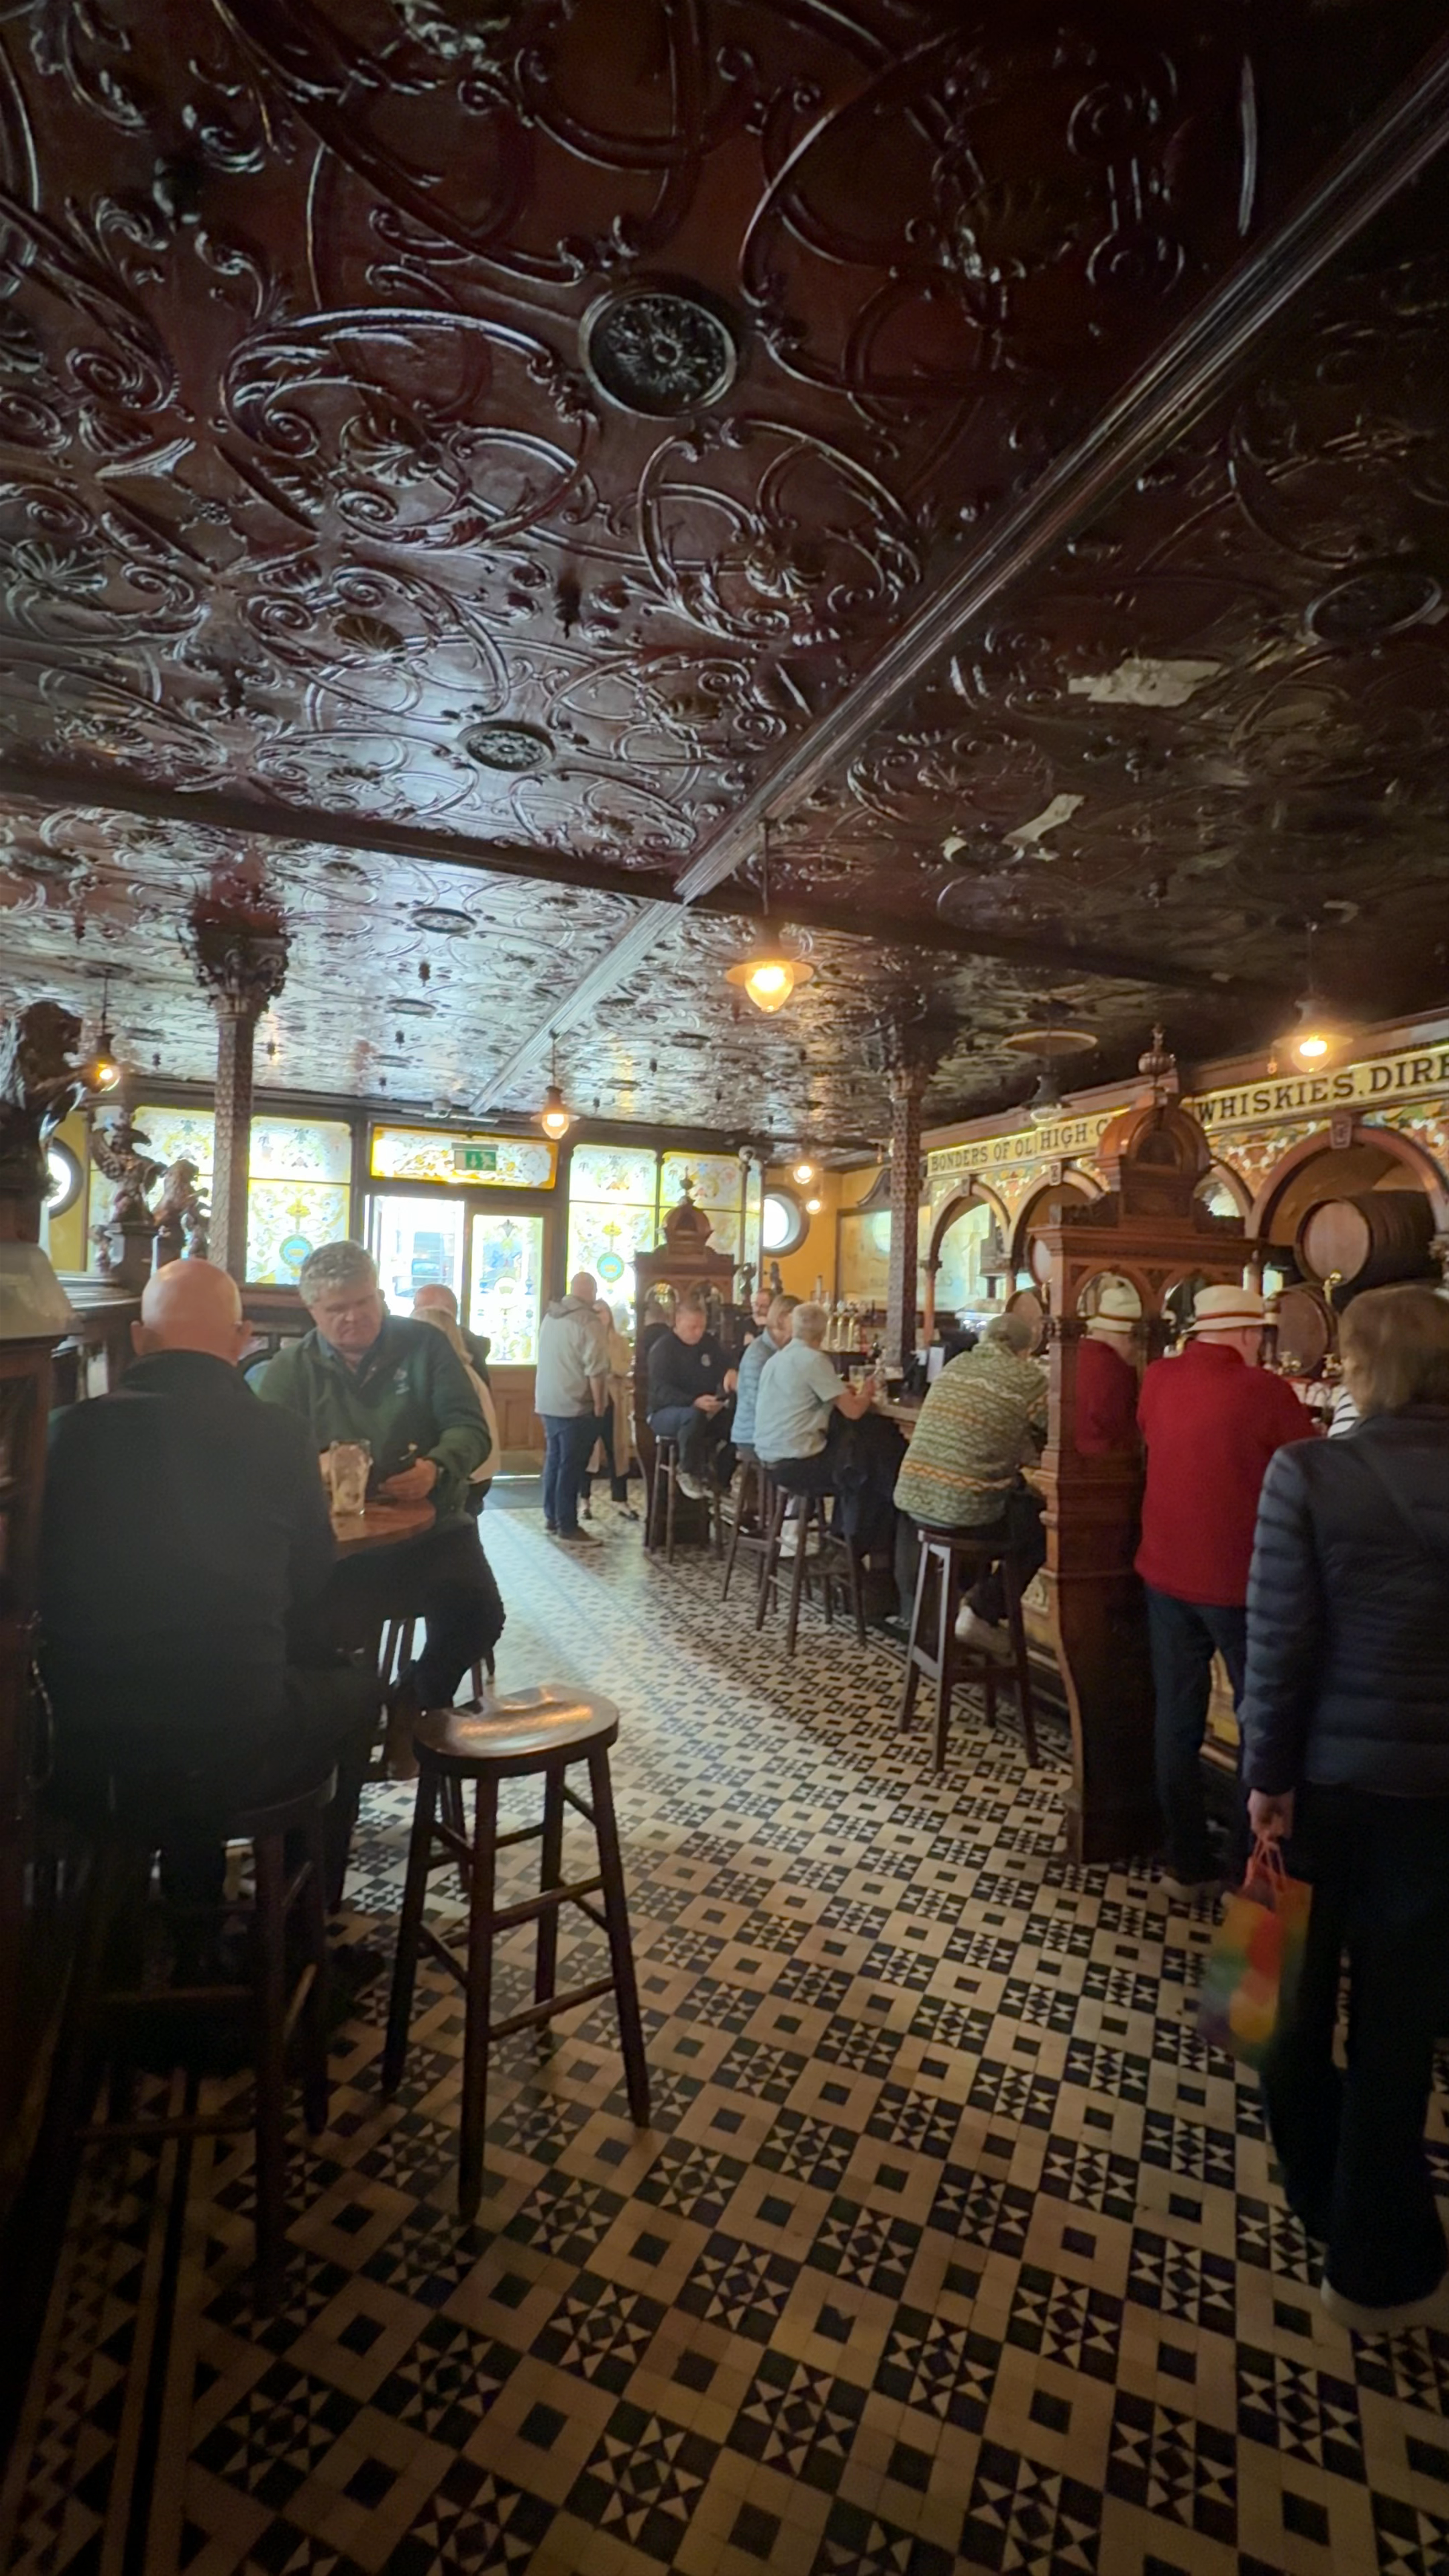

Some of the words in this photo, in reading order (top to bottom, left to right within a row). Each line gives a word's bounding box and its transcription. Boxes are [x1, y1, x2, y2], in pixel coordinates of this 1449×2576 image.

[931, 1146, 988, 1172] BONDERS
[994, 1141, 1010, 1161] OF
[1015, 1137, 1037, 1158] OL
[1040, 1123, 1087, 1150] HIGH
